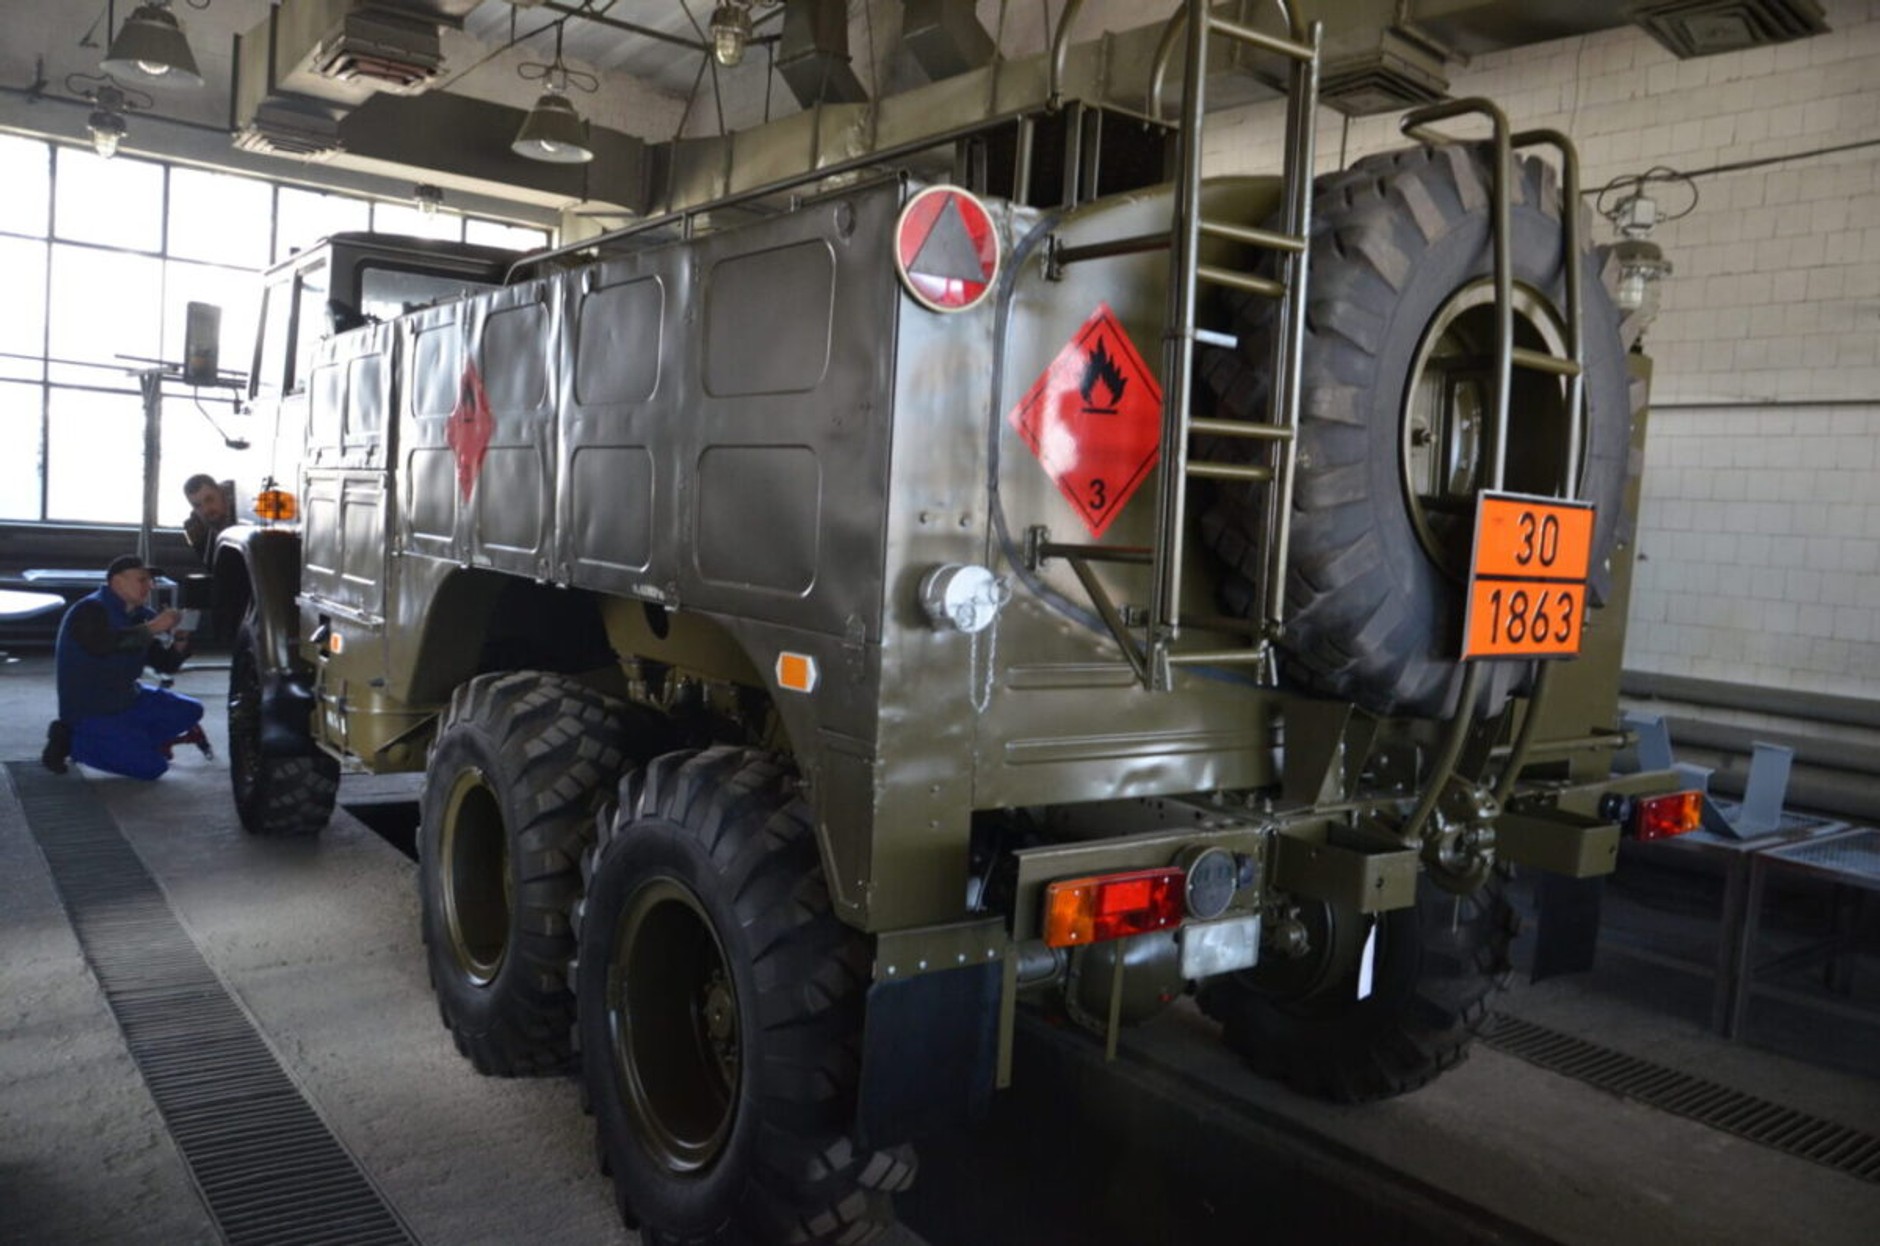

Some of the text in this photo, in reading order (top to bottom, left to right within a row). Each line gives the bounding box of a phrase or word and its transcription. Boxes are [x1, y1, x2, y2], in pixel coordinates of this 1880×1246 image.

[1088, 479, 1106, 510] 3
[1515, 511, 1559, 567] 30
[1490, 589, 1574, 644] 1863
